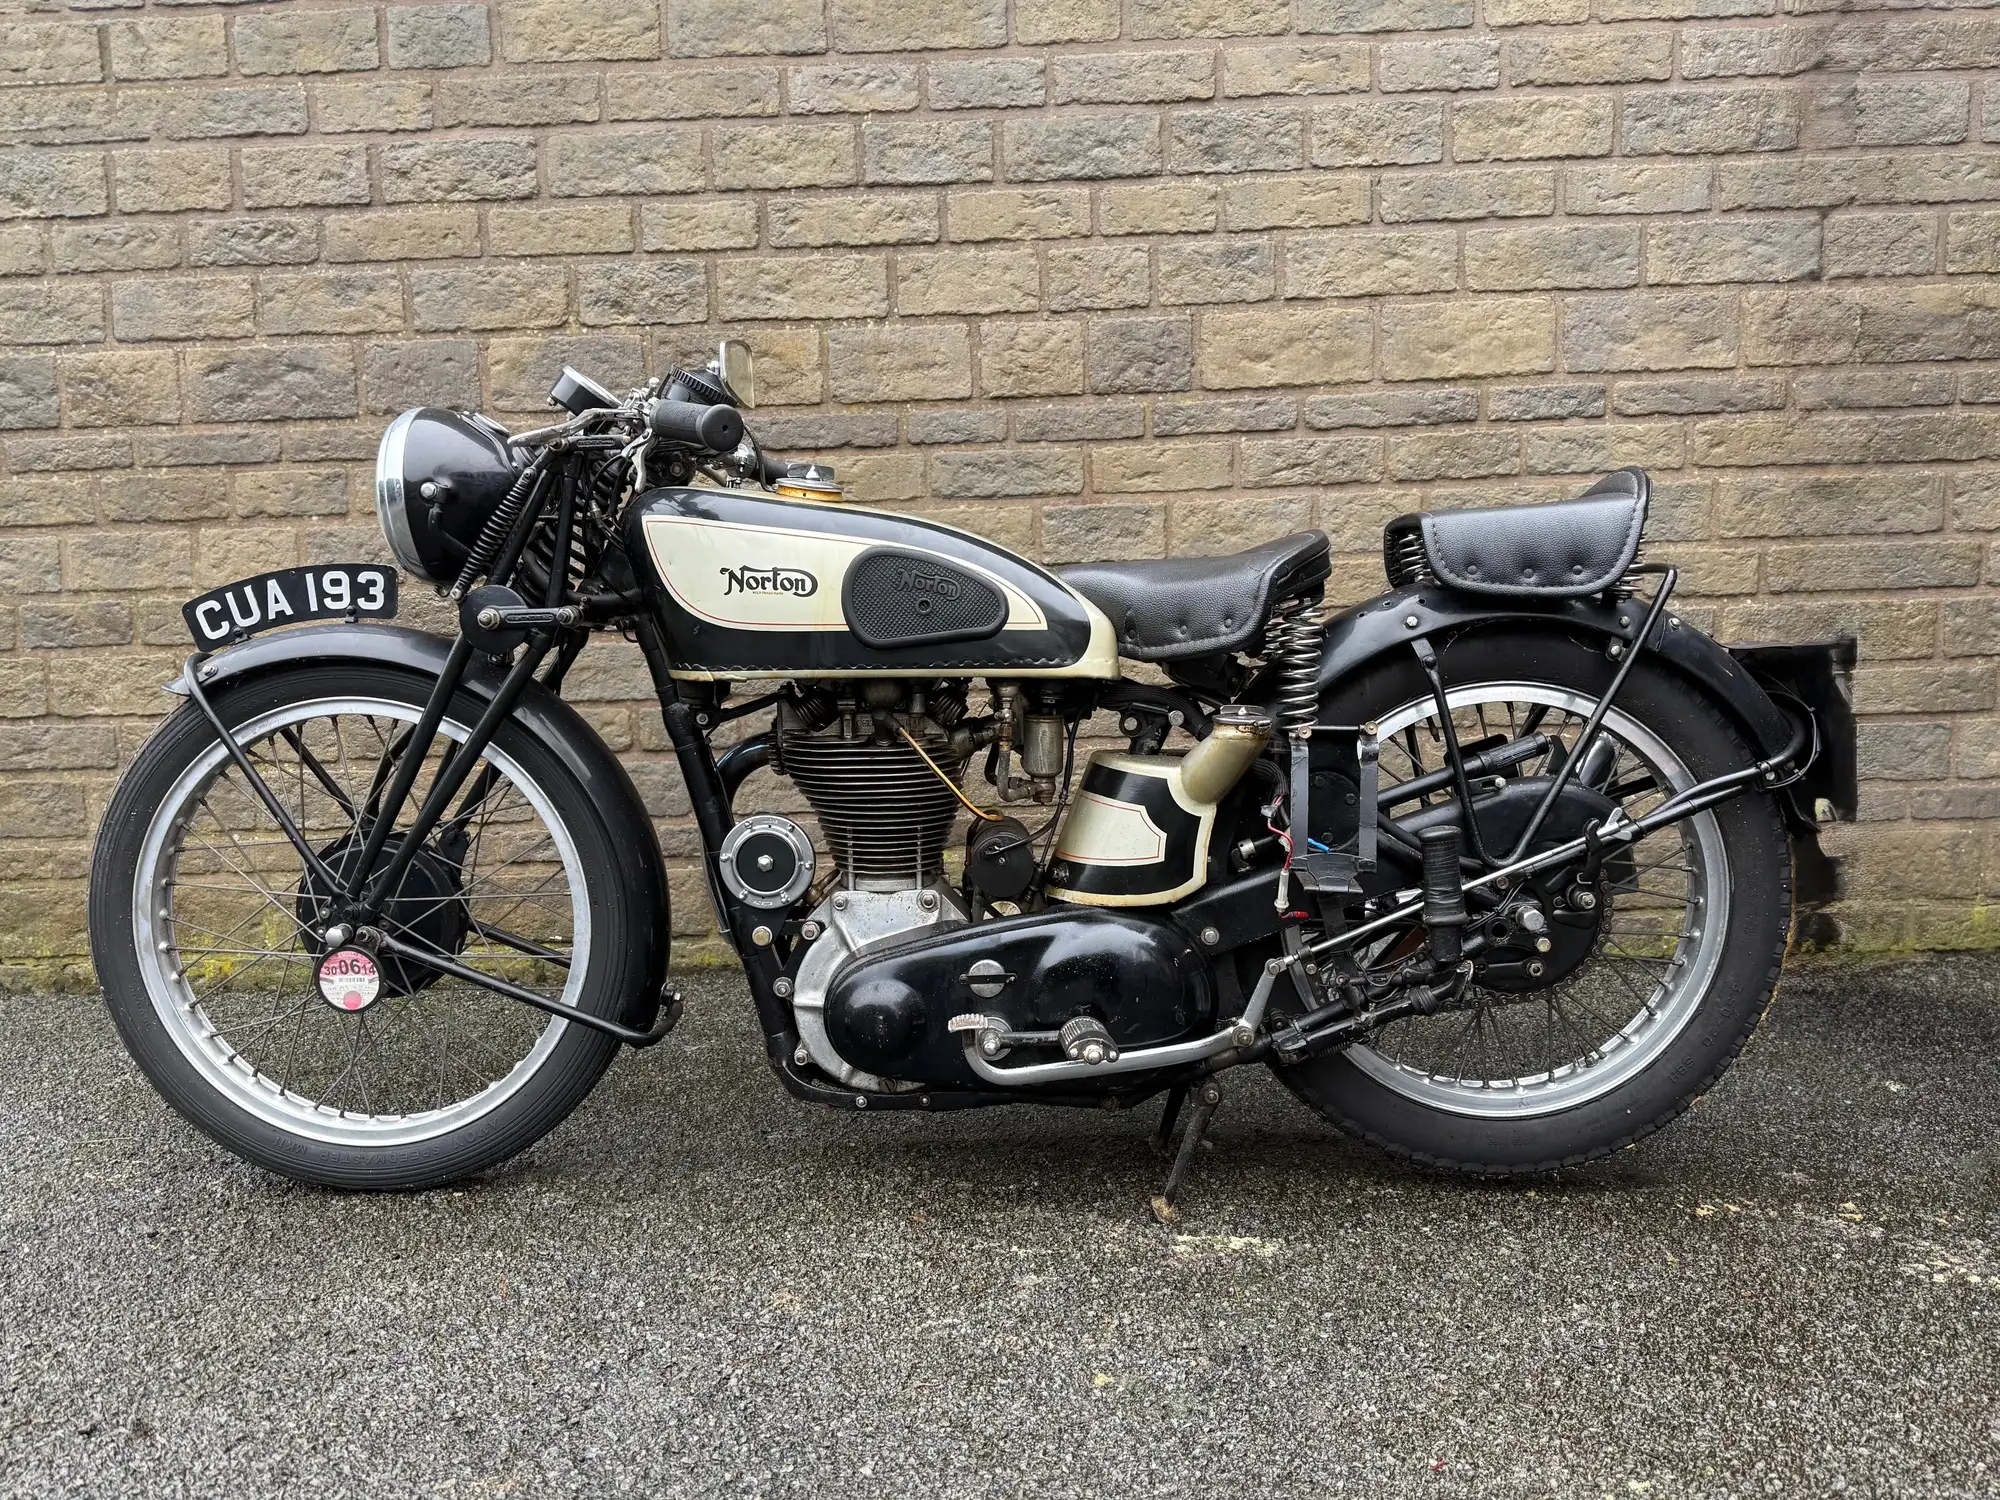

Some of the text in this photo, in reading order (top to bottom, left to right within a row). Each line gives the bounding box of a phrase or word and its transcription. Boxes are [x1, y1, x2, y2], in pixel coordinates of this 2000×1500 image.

[719, 565, 818, 598] Norton
[896, 568, 961, 601] Norton
[195, 570, 385, 640] CUA 193
[324, 959, 376, 976] 30 06 14
[319, 1144, 440, 1165] SPEEDMASTER
